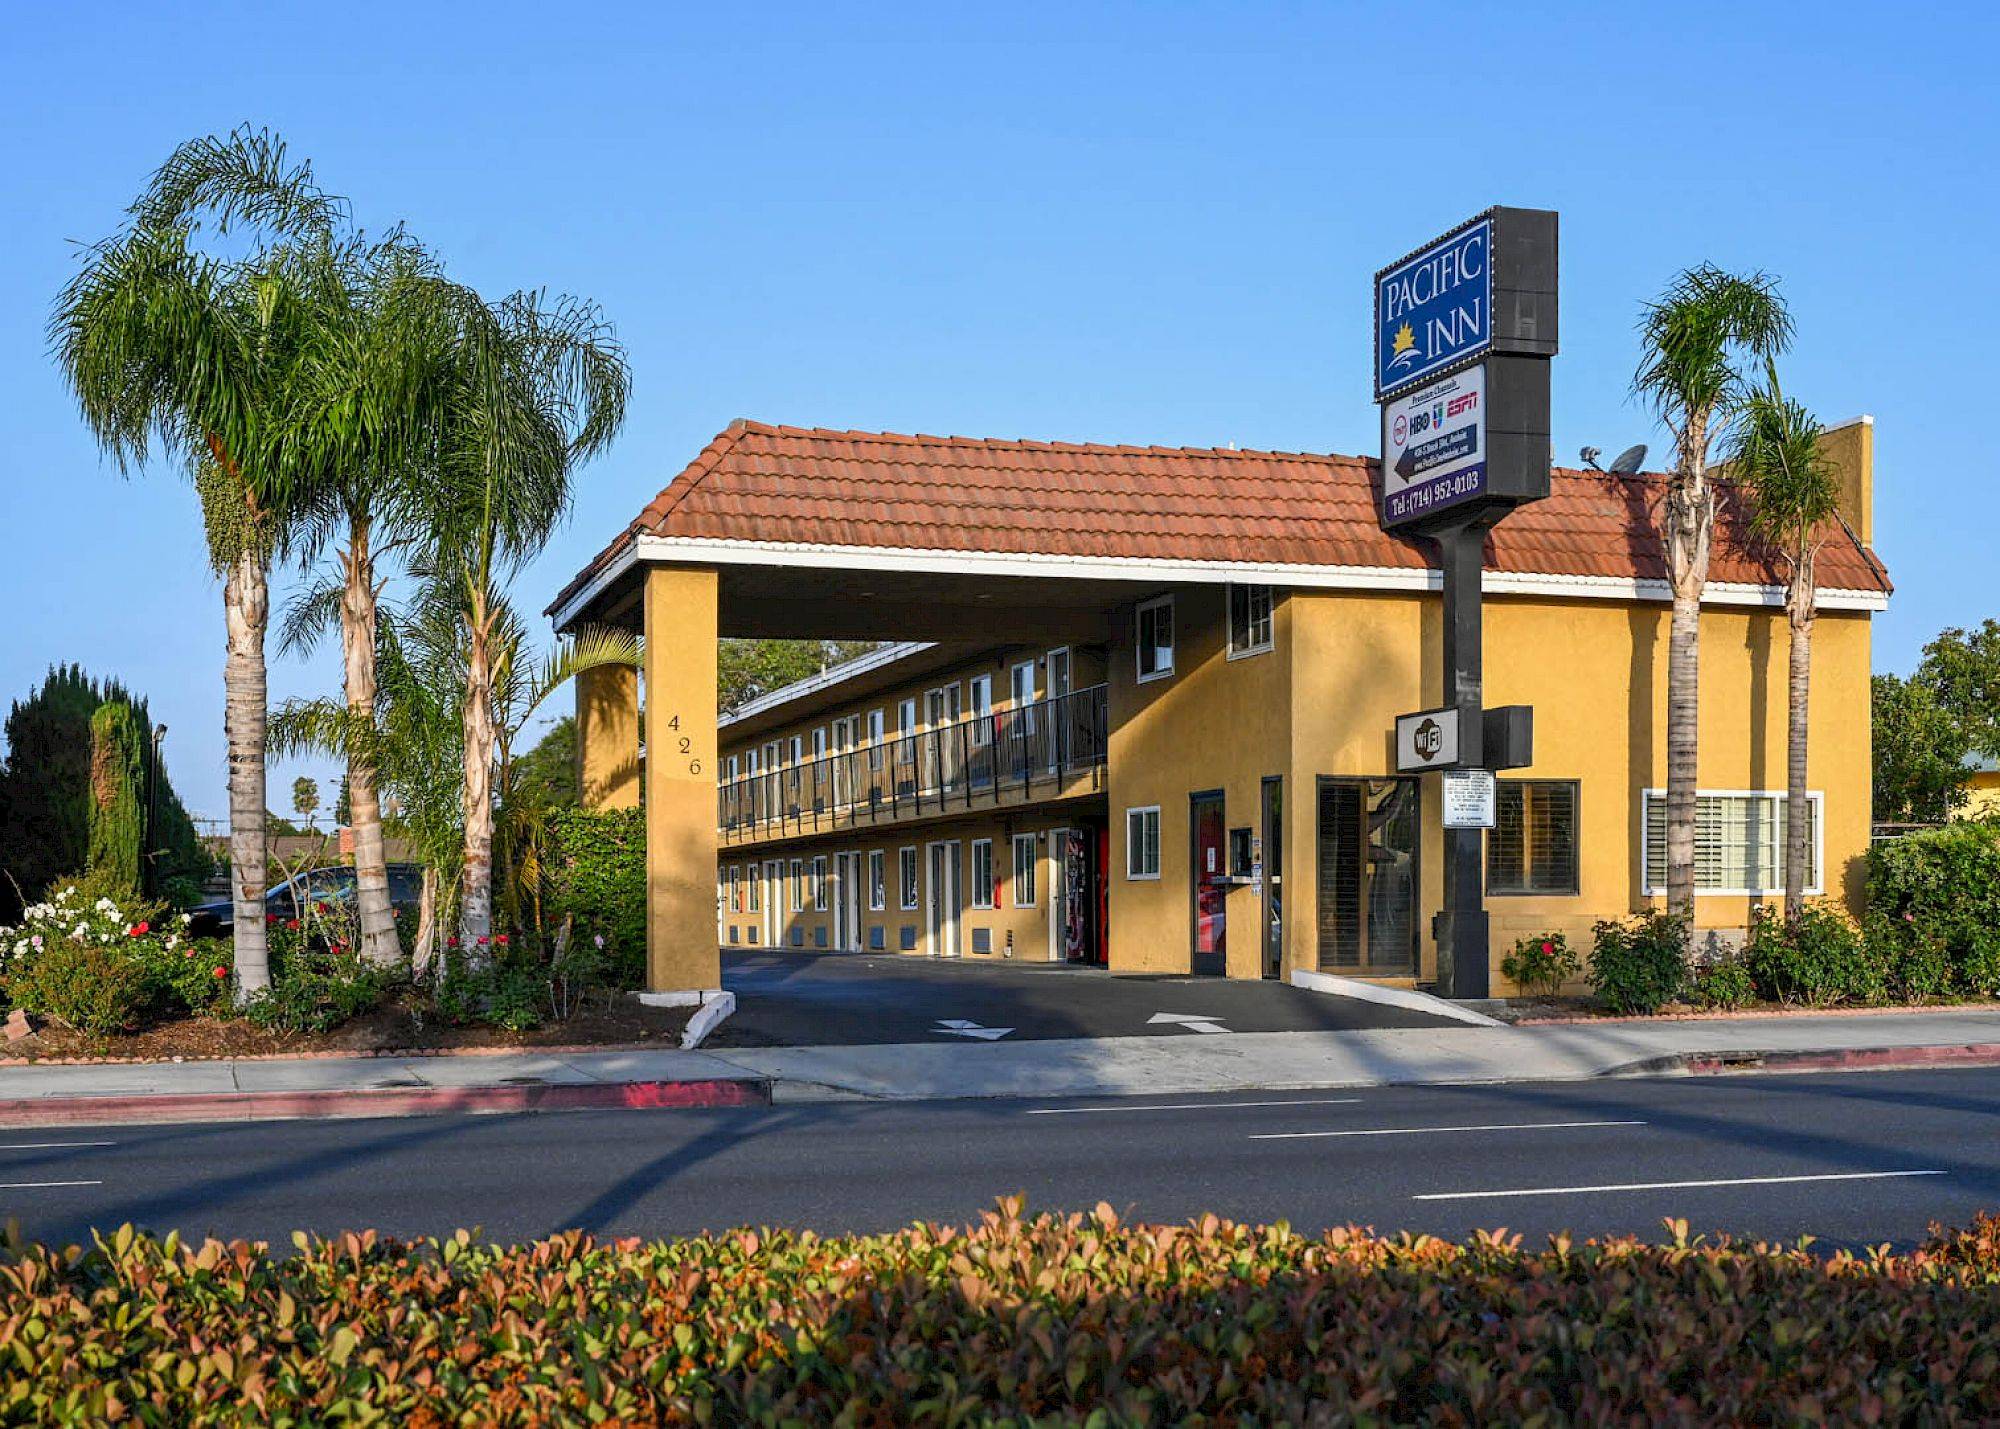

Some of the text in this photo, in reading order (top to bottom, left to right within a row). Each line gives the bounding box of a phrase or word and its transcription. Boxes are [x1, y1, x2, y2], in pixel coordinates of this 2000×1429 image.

[1386, 236, 1481, 322] PACIFIC
[1426, 298, 1481, 360] INN
[1409, 412, 1430, 436] HBO
[1447, 397, 1477, 418] ESPN
[1434, 471, 1479, 502] 952-0103
